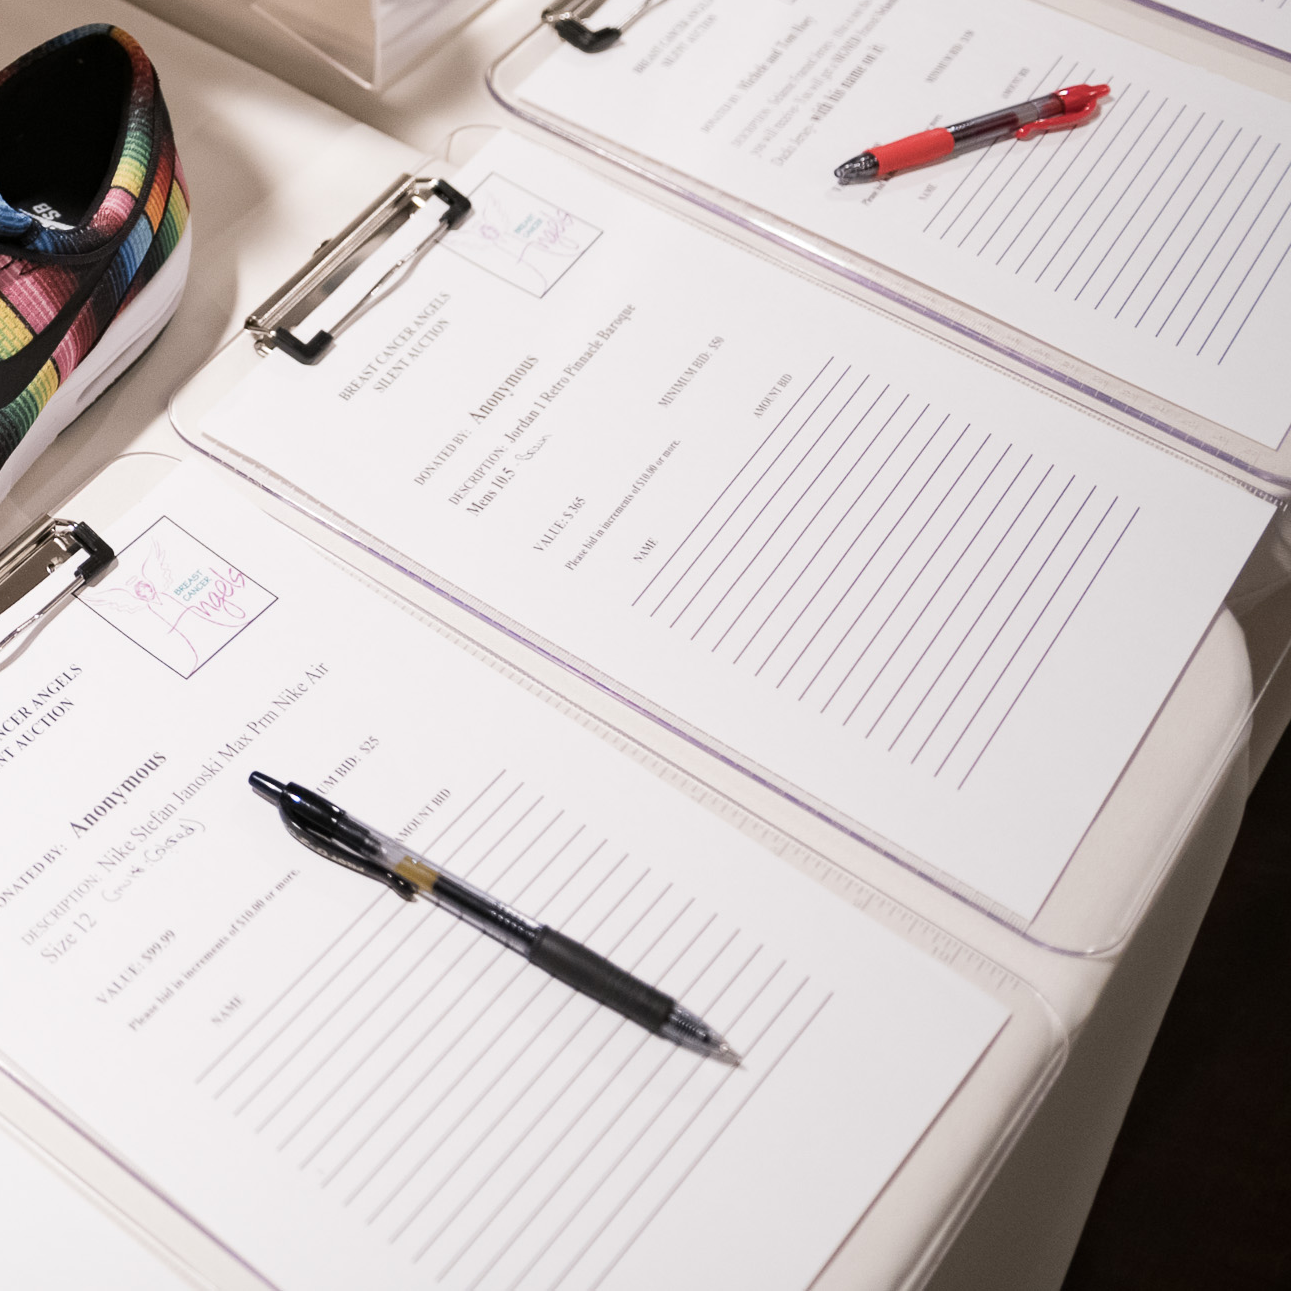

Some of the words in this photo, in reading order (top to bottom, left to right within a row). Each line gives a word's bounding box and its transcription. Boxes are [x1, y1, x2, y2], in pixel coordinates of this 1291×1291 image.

[338, 362, 378, 401] BREAST
[375, 327, 417, 365] CANCER
[413, 292, 451, 329] ANGELS
[373, 358, 409, 393] SILENT
[407, 318, 449, 361] AUCTION
[658, 367, 698, 408] MINIMUM
[691, 352, 712, 369] BID:
[708, 336, 724, 350] $50
[448, 446, 508, 505] DESCRIPTION:
[504, 410, 540, 443] Jordan
[539, 377, 570, 402] Retro
[563, 340, 603, 377] Pinnacle
[596, 304, 635, 340] Baroque
[753, 386, 782, 418] AMOUNT
[776, 374, 792, 388] BID
[414, 444, 456, 485] DONATED
[452, 430, 472, 445] BY:
[469, 356, 538, 425] Anonymous
[655, 457, 664, 466] or
[662, 441, 681, 458] more.
[466, 490, 497, 516] Mens
[491, 467, 515, 489] 10.5
[632, 481, 641, 494] of
[635, 464, 658, 487] $10.00
[533, 519, 568, 551] VALUE:
[568, 496, 585, 513] 365
[599, 491, 636, 530] increments
[565, 549, 588, 570] Please
[582, 536, 598, 549] bid
[633, 538, 656, 561] NAME
[173, 569, 202, 596] BREAST
[183, 576, 212, 601] CANCER
[32, 666, 82, 710] ANGELS
[16, 701, 74, 748] AUCTION
[335, 756, 361, 777] BID:
[359, 736, 379, 754] $25
[21, 875, 102, 946] DESCRIPTION:
[96, 841, 136, 872] Nike
[130, 804, 178, 842] Stefan
[172, 758, 224, 805] Janoski
[217, 734, 253, 762] Max
[246, 711, 279, 735] Prm
[271, 683, 308, 711] Nike
[305, 663, 328, 684] Air
[43, 845, 67, 864] BY:
[70, 752, 166, 838] Anonymous
[431, 789, 451, 806] BID
[40, 933, 77, 964] Size
[73, 913, 97, 933] 12
[128, 1004, 159, 1032] Please
[155, 987, 175, 1005] bid
[171, 979, 185, 990] in
[181, 936, 230, 980] increments
[229, 923, 240, 937] of
[264, 890, 275, 901] or
[275, 870, 300, 891] more.
[96, 963, 144, 1003] VALUE:
[141, 930, 176, 962] $99.99
[211, 995, 244, 1024] NAME
